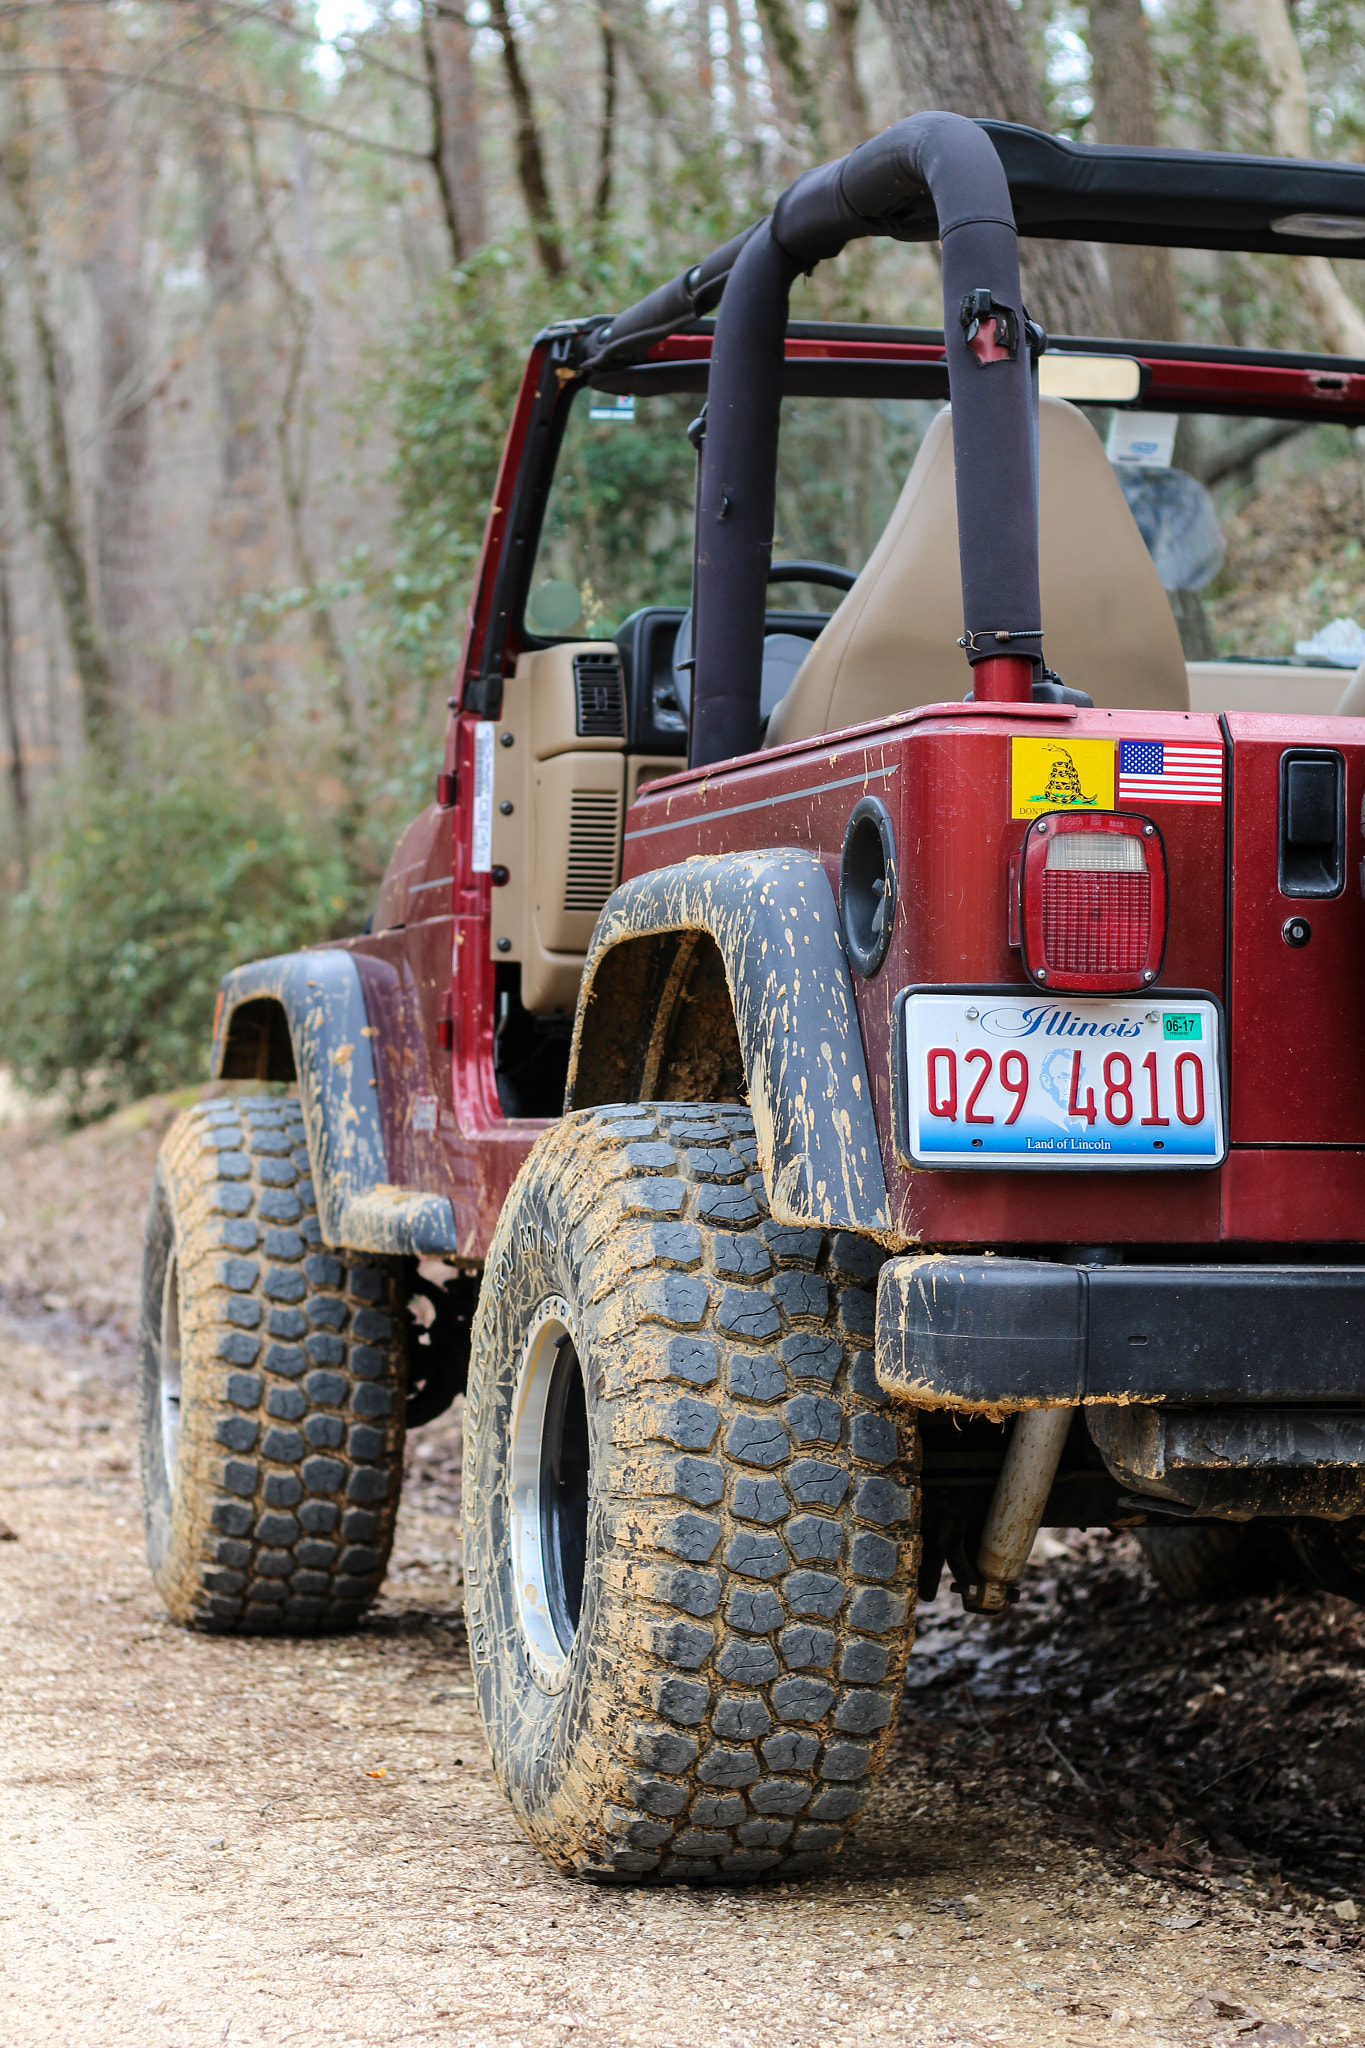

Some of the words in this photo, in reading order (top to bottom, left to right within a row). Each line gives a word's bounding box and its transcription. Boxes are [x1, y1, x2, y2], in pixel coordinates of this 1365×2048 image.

[980, 1004, 1144, 1037] Illinois
[1166, 1019, 1195, 1031] 06-17
[927, 1047, 1029, 1125] Q29
[1068, 1049, 1204, 1126] 4810
[1026, 1138, 1054, 1149] Land
[1056, 1138, 1068, 1149] of
[1071, 1138, 1111, 1150] Lincoln
